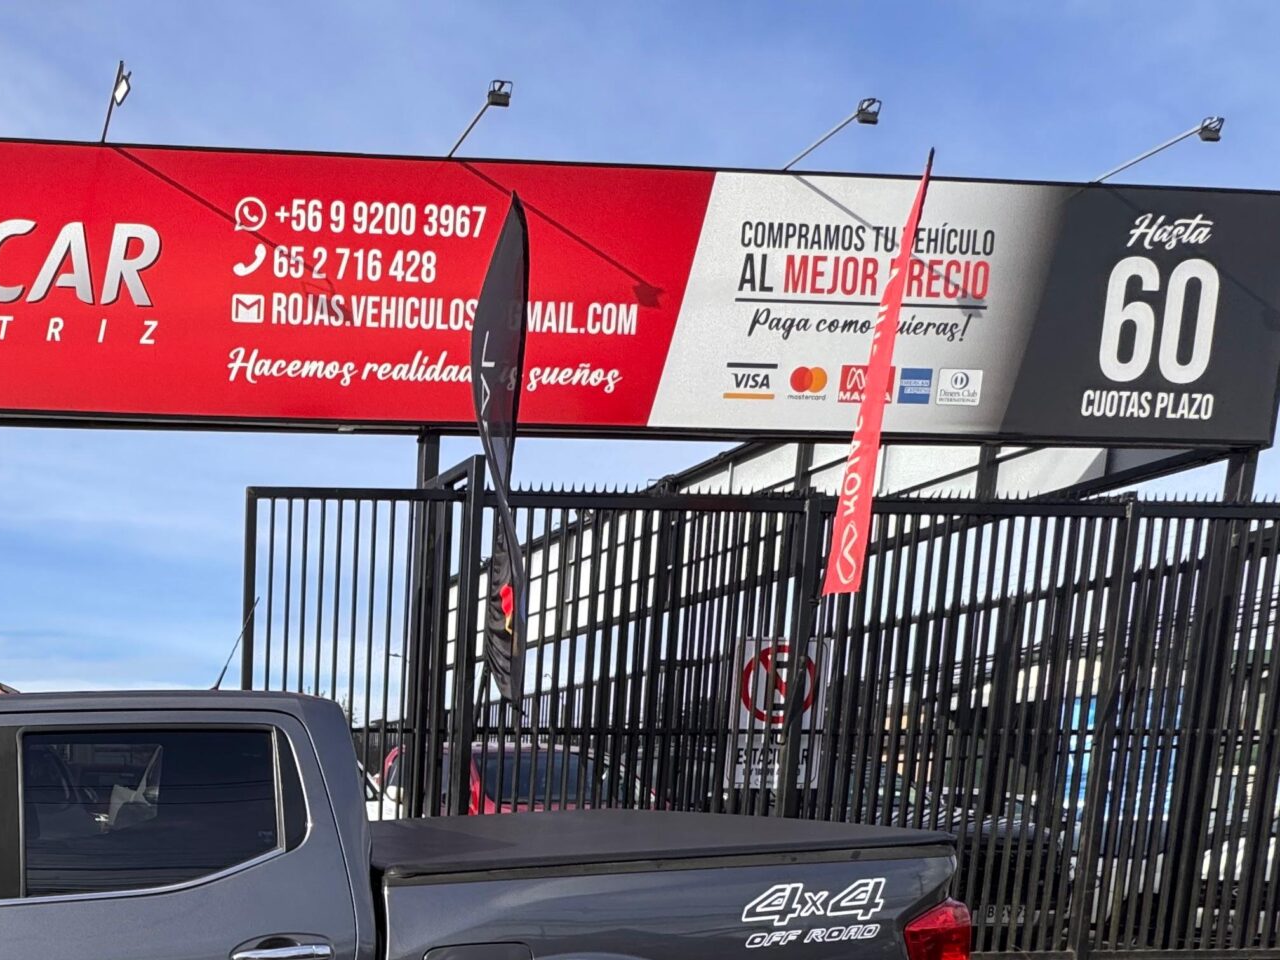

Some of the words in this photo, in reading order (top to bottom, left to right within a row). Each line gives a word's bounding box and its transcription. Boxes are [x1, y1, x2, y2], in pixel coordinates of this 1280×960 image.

[274, 198, 323, 233] +56
[329, 200, 346, 234] 9
[352, 201, 417, 236] 9200
[423, 203, 488, 238] 3967
[1126, 213, 1214, 250] Hasta
[740, 220, 866, 252] COMPRAMOS
[872, 225, 897, 253] TU
[903, 223, 996, 256] EHÍCULO
[273, 245, 305, 279] 65
[311, 246, 328, 279] 2
[335, 247, 383, 281] 716
[388, 250, 437, 283] 428
[737, 252, 774, 293] AL
[783, 254, 879, 296] MEJOR
[747, 308, 812, 340] Paga
[815, 316, 873, 335] como
[896, 313, 973, 342] uieras!
[1099, 255, 1220, 385] 60
[227, 346, 358, 387] Hacemos
[526, 363, 624, 394] sueños
[731, 373, 770, 389] VISA
[787, 393, 827, 401] mastercard
[961, 388, 978, 398] Club
[1080, 389, 1151, 418] CUOTAS
[1154, 392, 1215, 420] PLAZO
[741, 877, 886, 927] 4x4
[745, 929, 803, 949] OFF
[803, 924, 881, 944] ROAD
